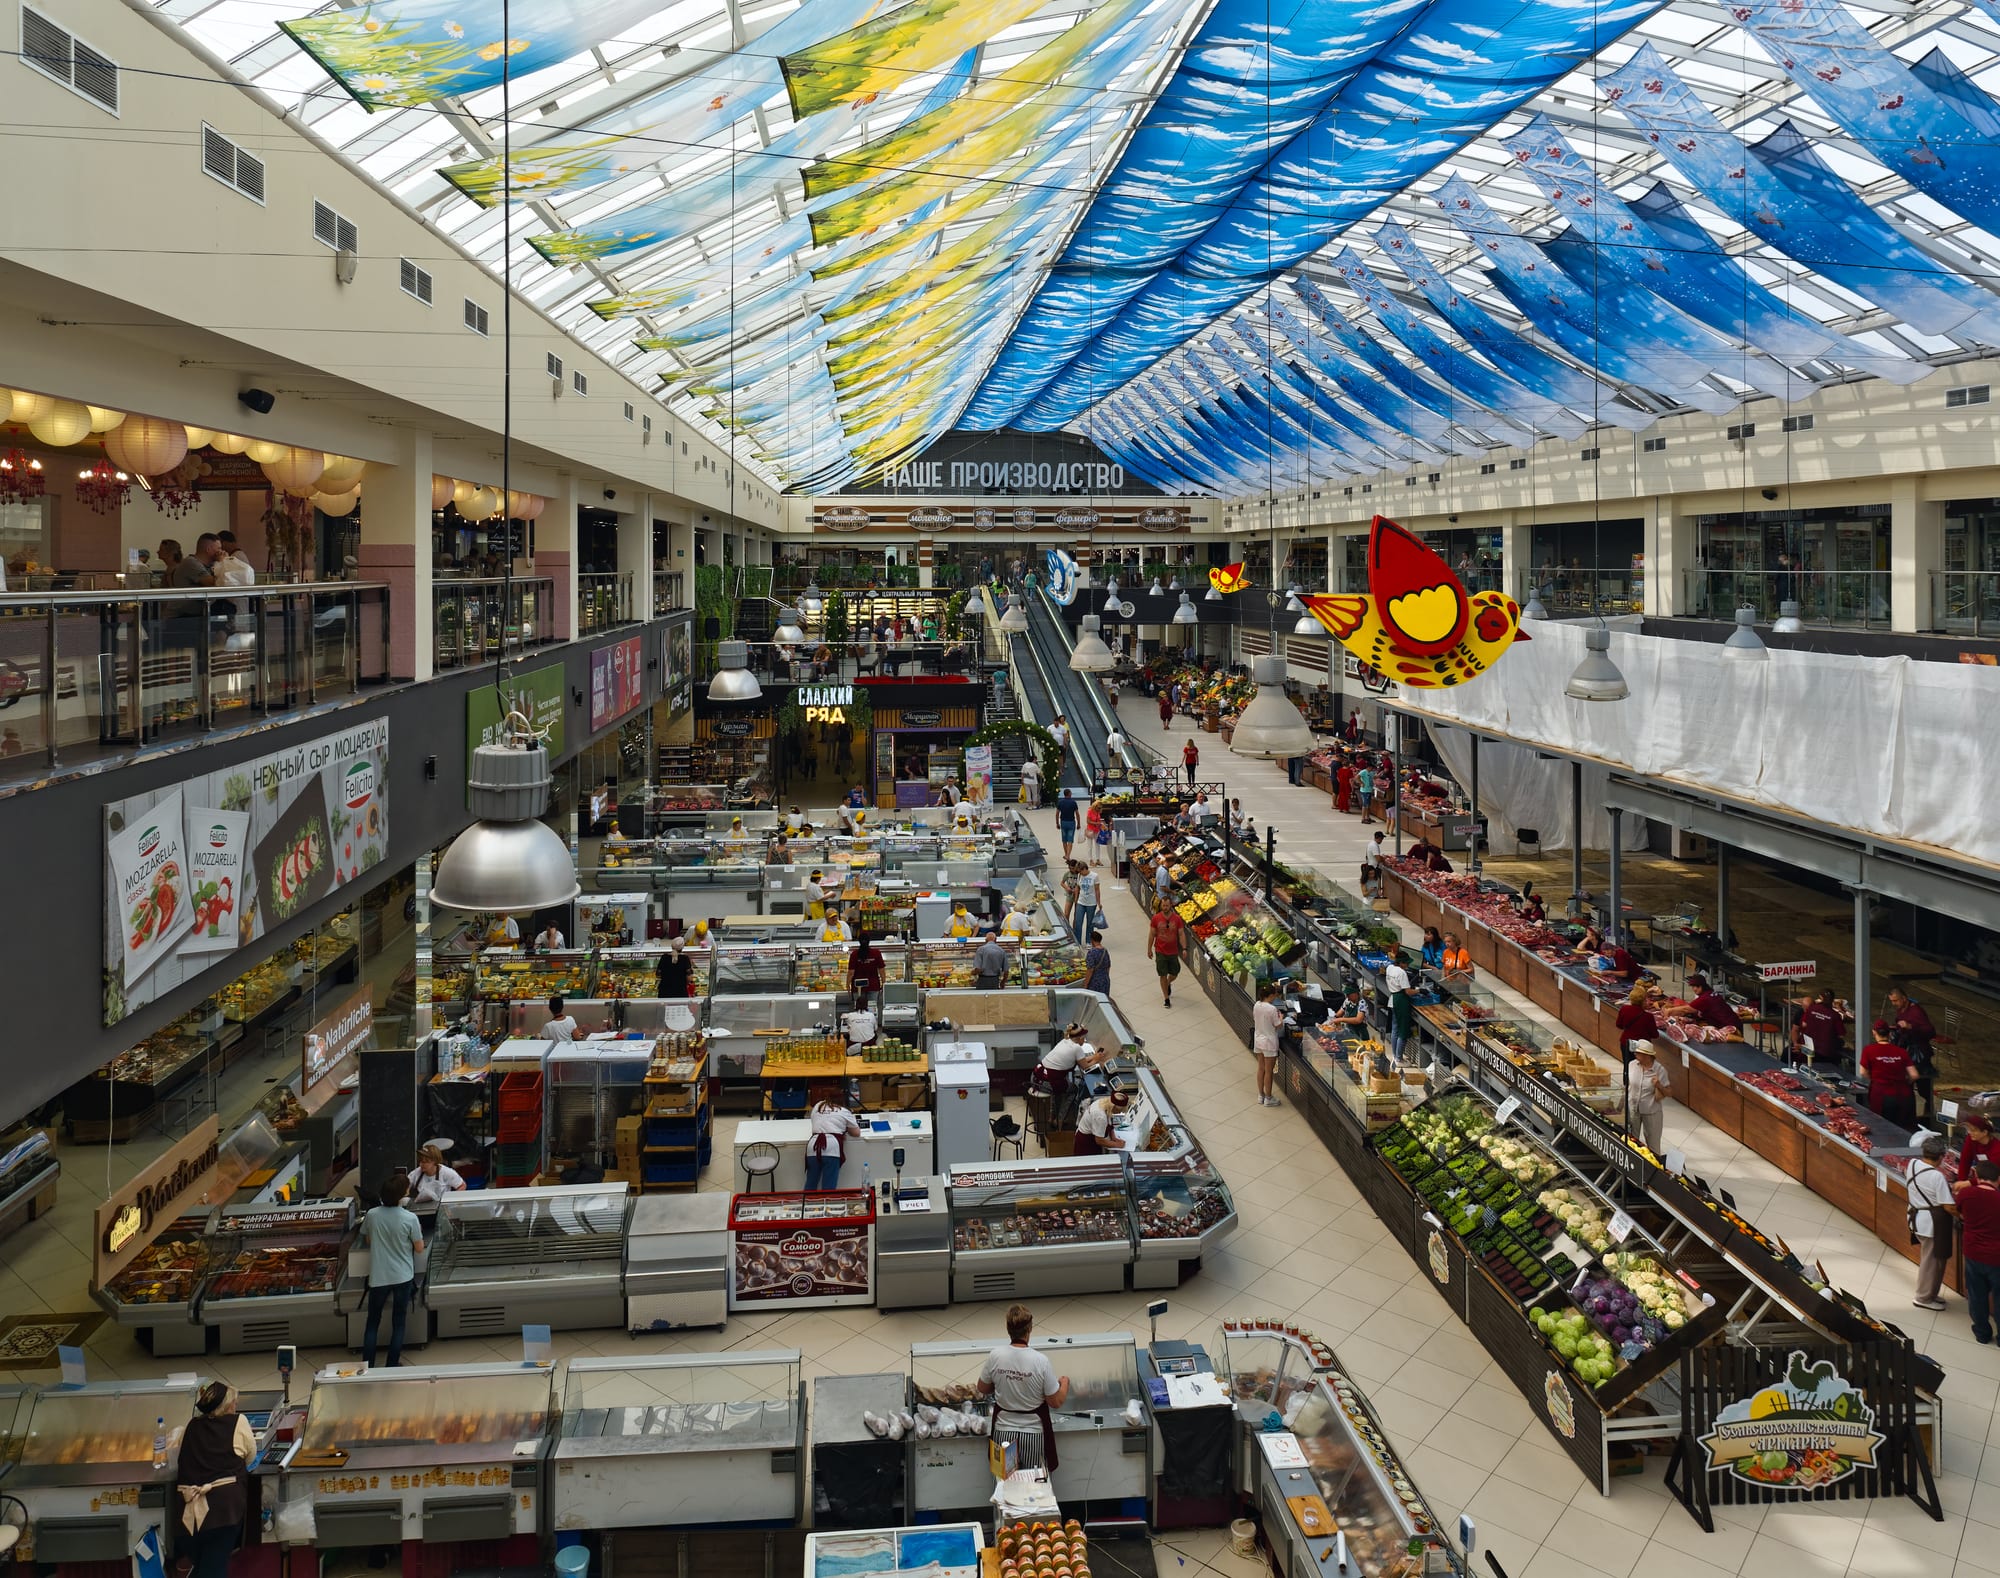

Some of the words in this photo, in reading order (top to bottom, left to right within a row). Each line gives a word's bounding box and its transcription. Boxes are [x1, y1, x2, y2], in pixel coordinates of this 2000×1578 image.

[883, 462, 943, 488] НАШЕ
[951, 462, 1123, 492] ПРОИЗВОДСТВО
[798, 685, 853, 706] СЛАДКИЙ
[806, 707, 845, 724] РЯД
[720, 722, 748, 733] Гурман
[253, 749, 305, 791] НЕЖНЫЙ
[309, 745, 330, 770] СЫР
[334, 725, 387, 761] МОЦАРЕЛЛА
[345, 773, 374, 798] Felicita
[209, 831, 228, 843] Felicita
[125, 841, 177, 892] MOZZARELLA
[194, 852, 237, 866] MOZZARELLA
[193, 868, 206, 878] mini
[127, 882, 147, 905] classic
[1764, 964, 1815, 977] БАРАНИНА
[326, 1001, 371, 1051] Natürliche
[307, 1046, 347, 1088] НАТУРАЛЬНЫЕ
[347, 1025, 371, 1053] КОЛБАСЫ
[1473, 1039, 1515, 1083] МИКРОЗЕЛЕНЬ
[1517, 1073, 1566, 1123] СОБСТВЕННОГО
[1569, 1112, 1630, 1172] ПРОИЗВОДСТВА
[244, 1213, 297, 1223] НАТУРАЛЬНЫЕ
[299, 1210, 335, 1220] КОЛБАСЫ
[783, 1242, 821, 1251] Сомово
[1757, 1436, 1830, 1451] ЯРМАРКА
